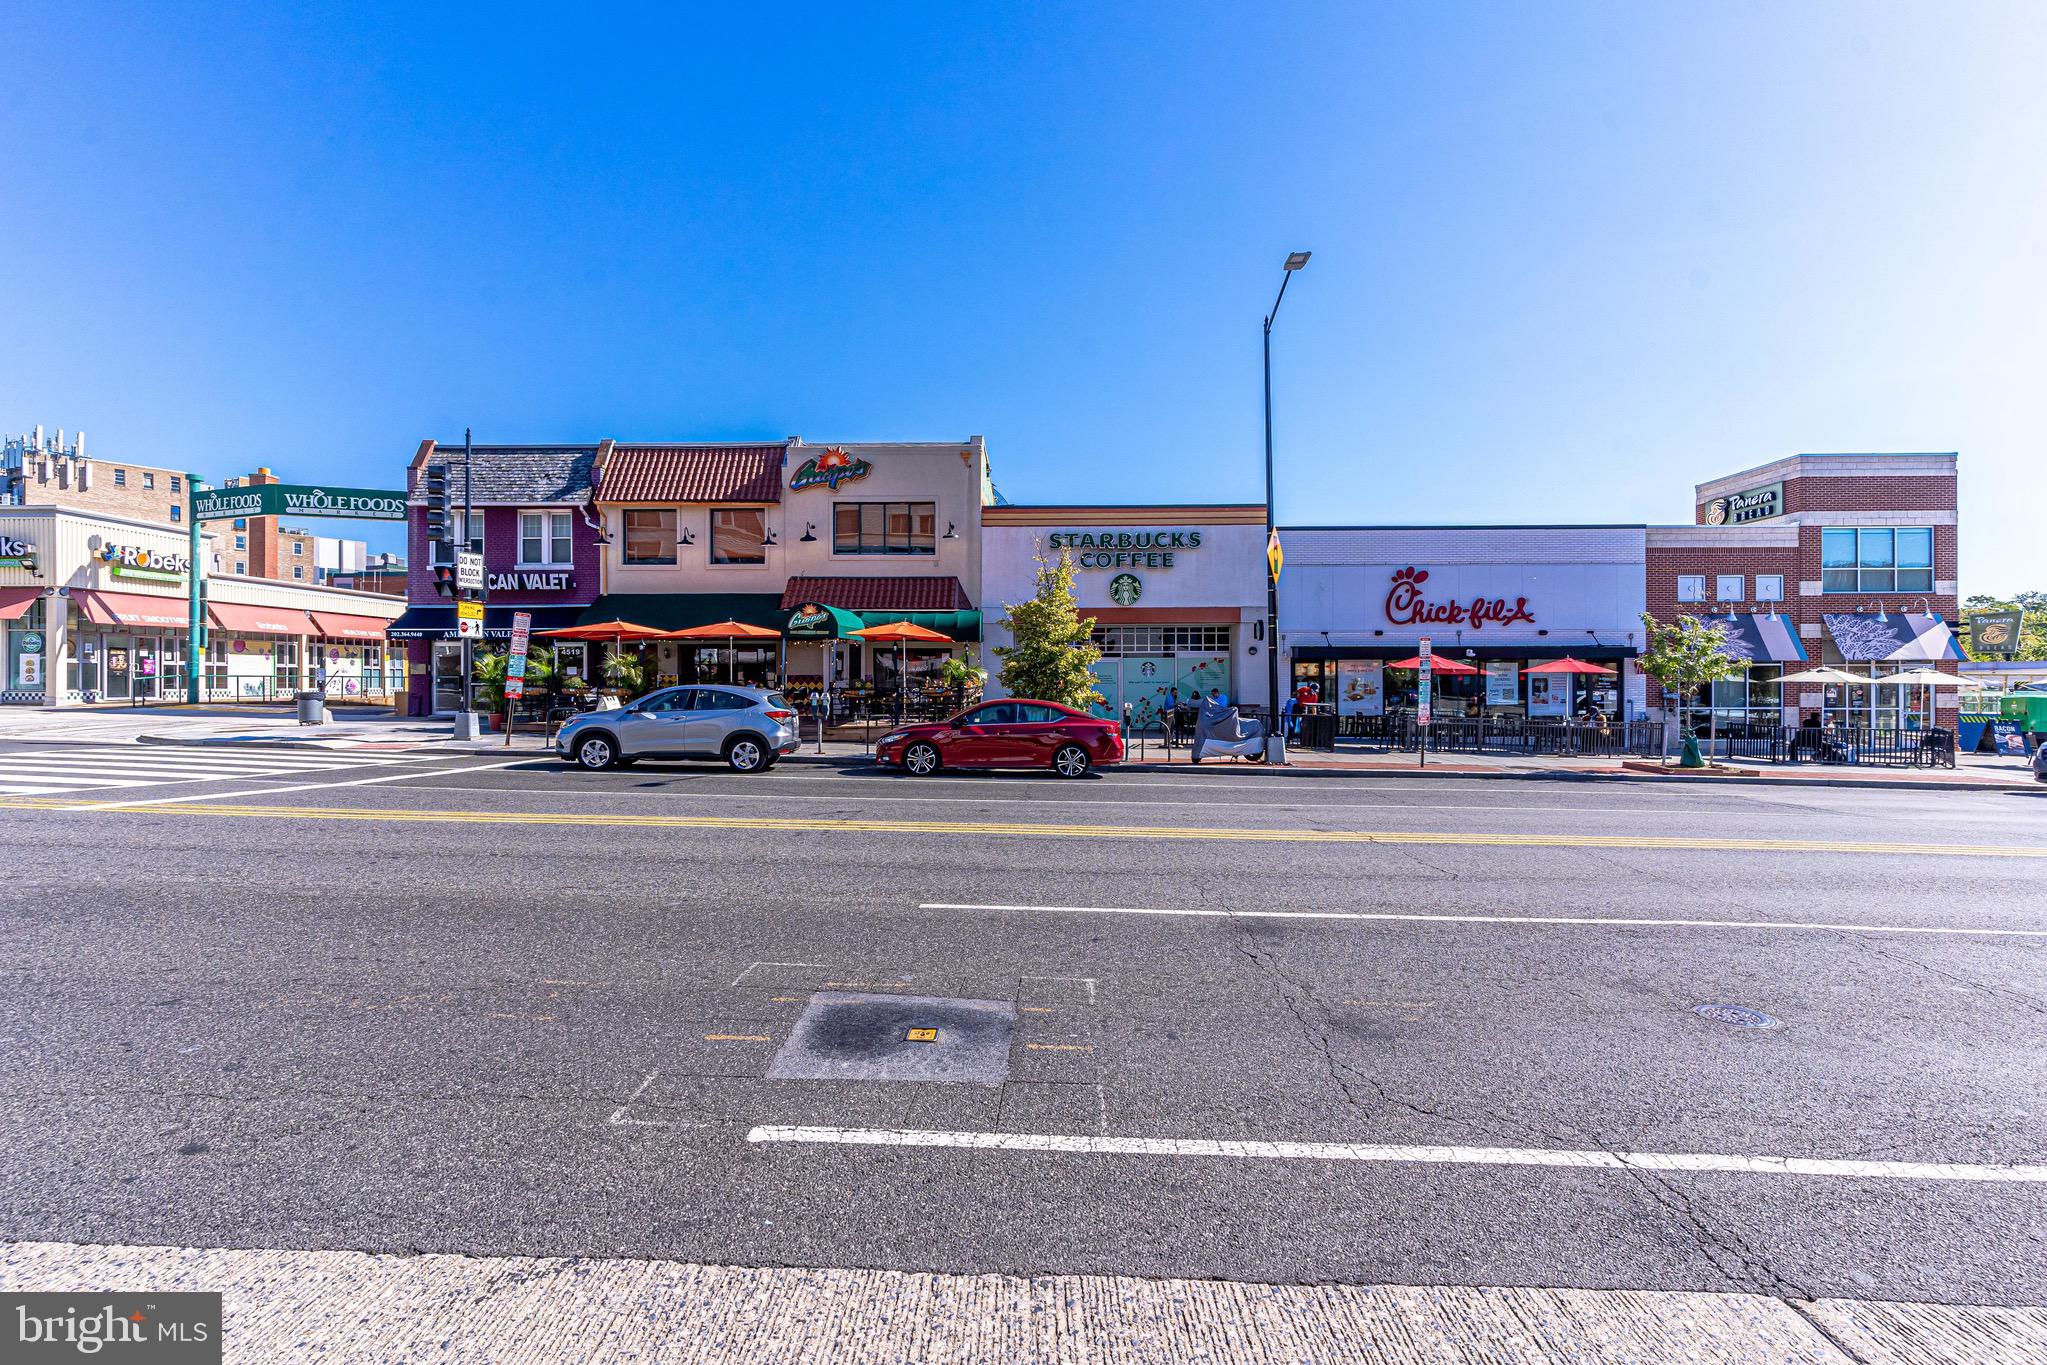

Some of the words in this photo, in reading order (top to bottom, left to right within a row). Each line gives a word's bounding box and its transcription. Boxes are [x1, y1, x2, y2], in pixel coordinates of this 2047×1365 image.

[196, 492, 229, 512] WHOLE
[230, 493, 262, 508] FOODS
[285, 489, 347, 509] WHOLE
[350, 496, 406, 512] FOODS
[1729, 491, 1772, 510] Panera
[298, 508, 396, 518] MARKET
[1733, 505, 1770, 522] BREAD
[1050, 532, 1201, 549] STARBUCKS
[124, 546, 190, 573] Robeks
[459, 556, 468, 565] DO
[470, 557, 481, 566] NOT
[1080, 551, 1175, 568] COFFEE
[460, 567, 480, 577] BLOCK
[488, 573, 519, 590] CAN
[522, 573, 569, 590] VALET
[1385, 578, 1536, 629] Chick-fil-A
[1975, 616, 2014, 624] Panera
[489, 630, 512, 638] VALE
